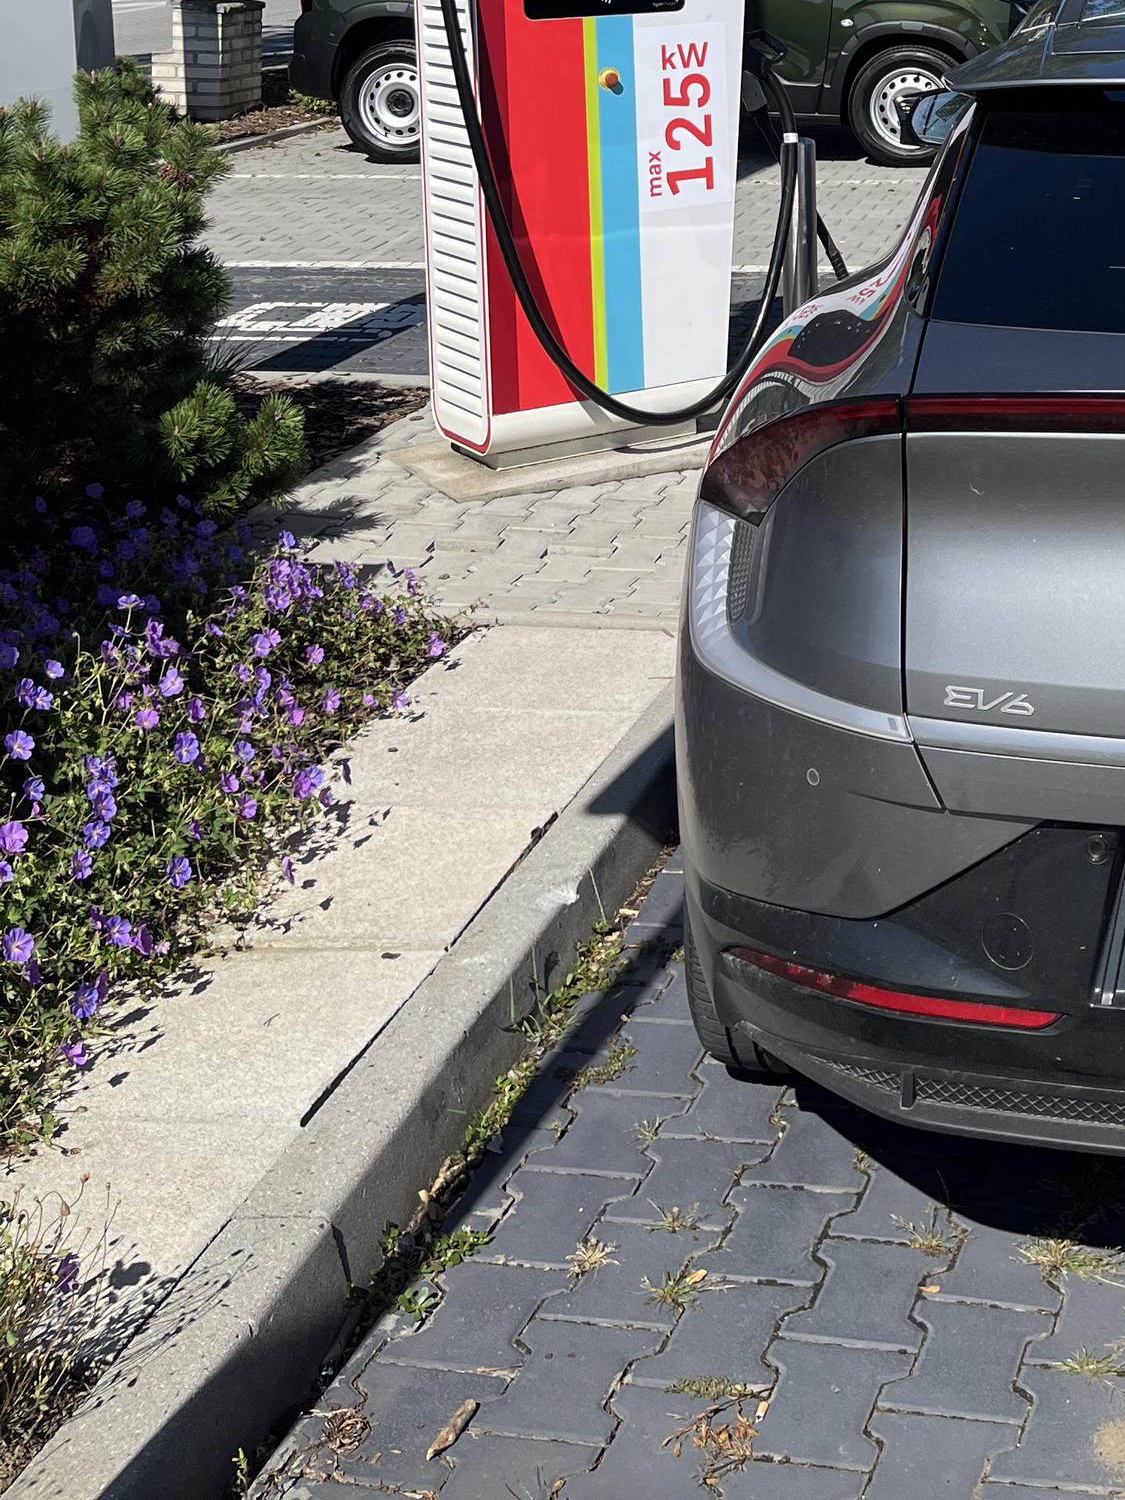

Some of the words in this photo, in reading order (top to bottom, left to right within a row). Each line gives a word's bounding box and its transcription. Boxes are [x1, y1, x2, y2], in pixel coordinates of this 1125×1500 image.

[661, 41, 708, 71] kW
[663, 73, 714, 195] 125
[649, 151, 662, 197] max
[943, 685, 1035, 716] EV6
